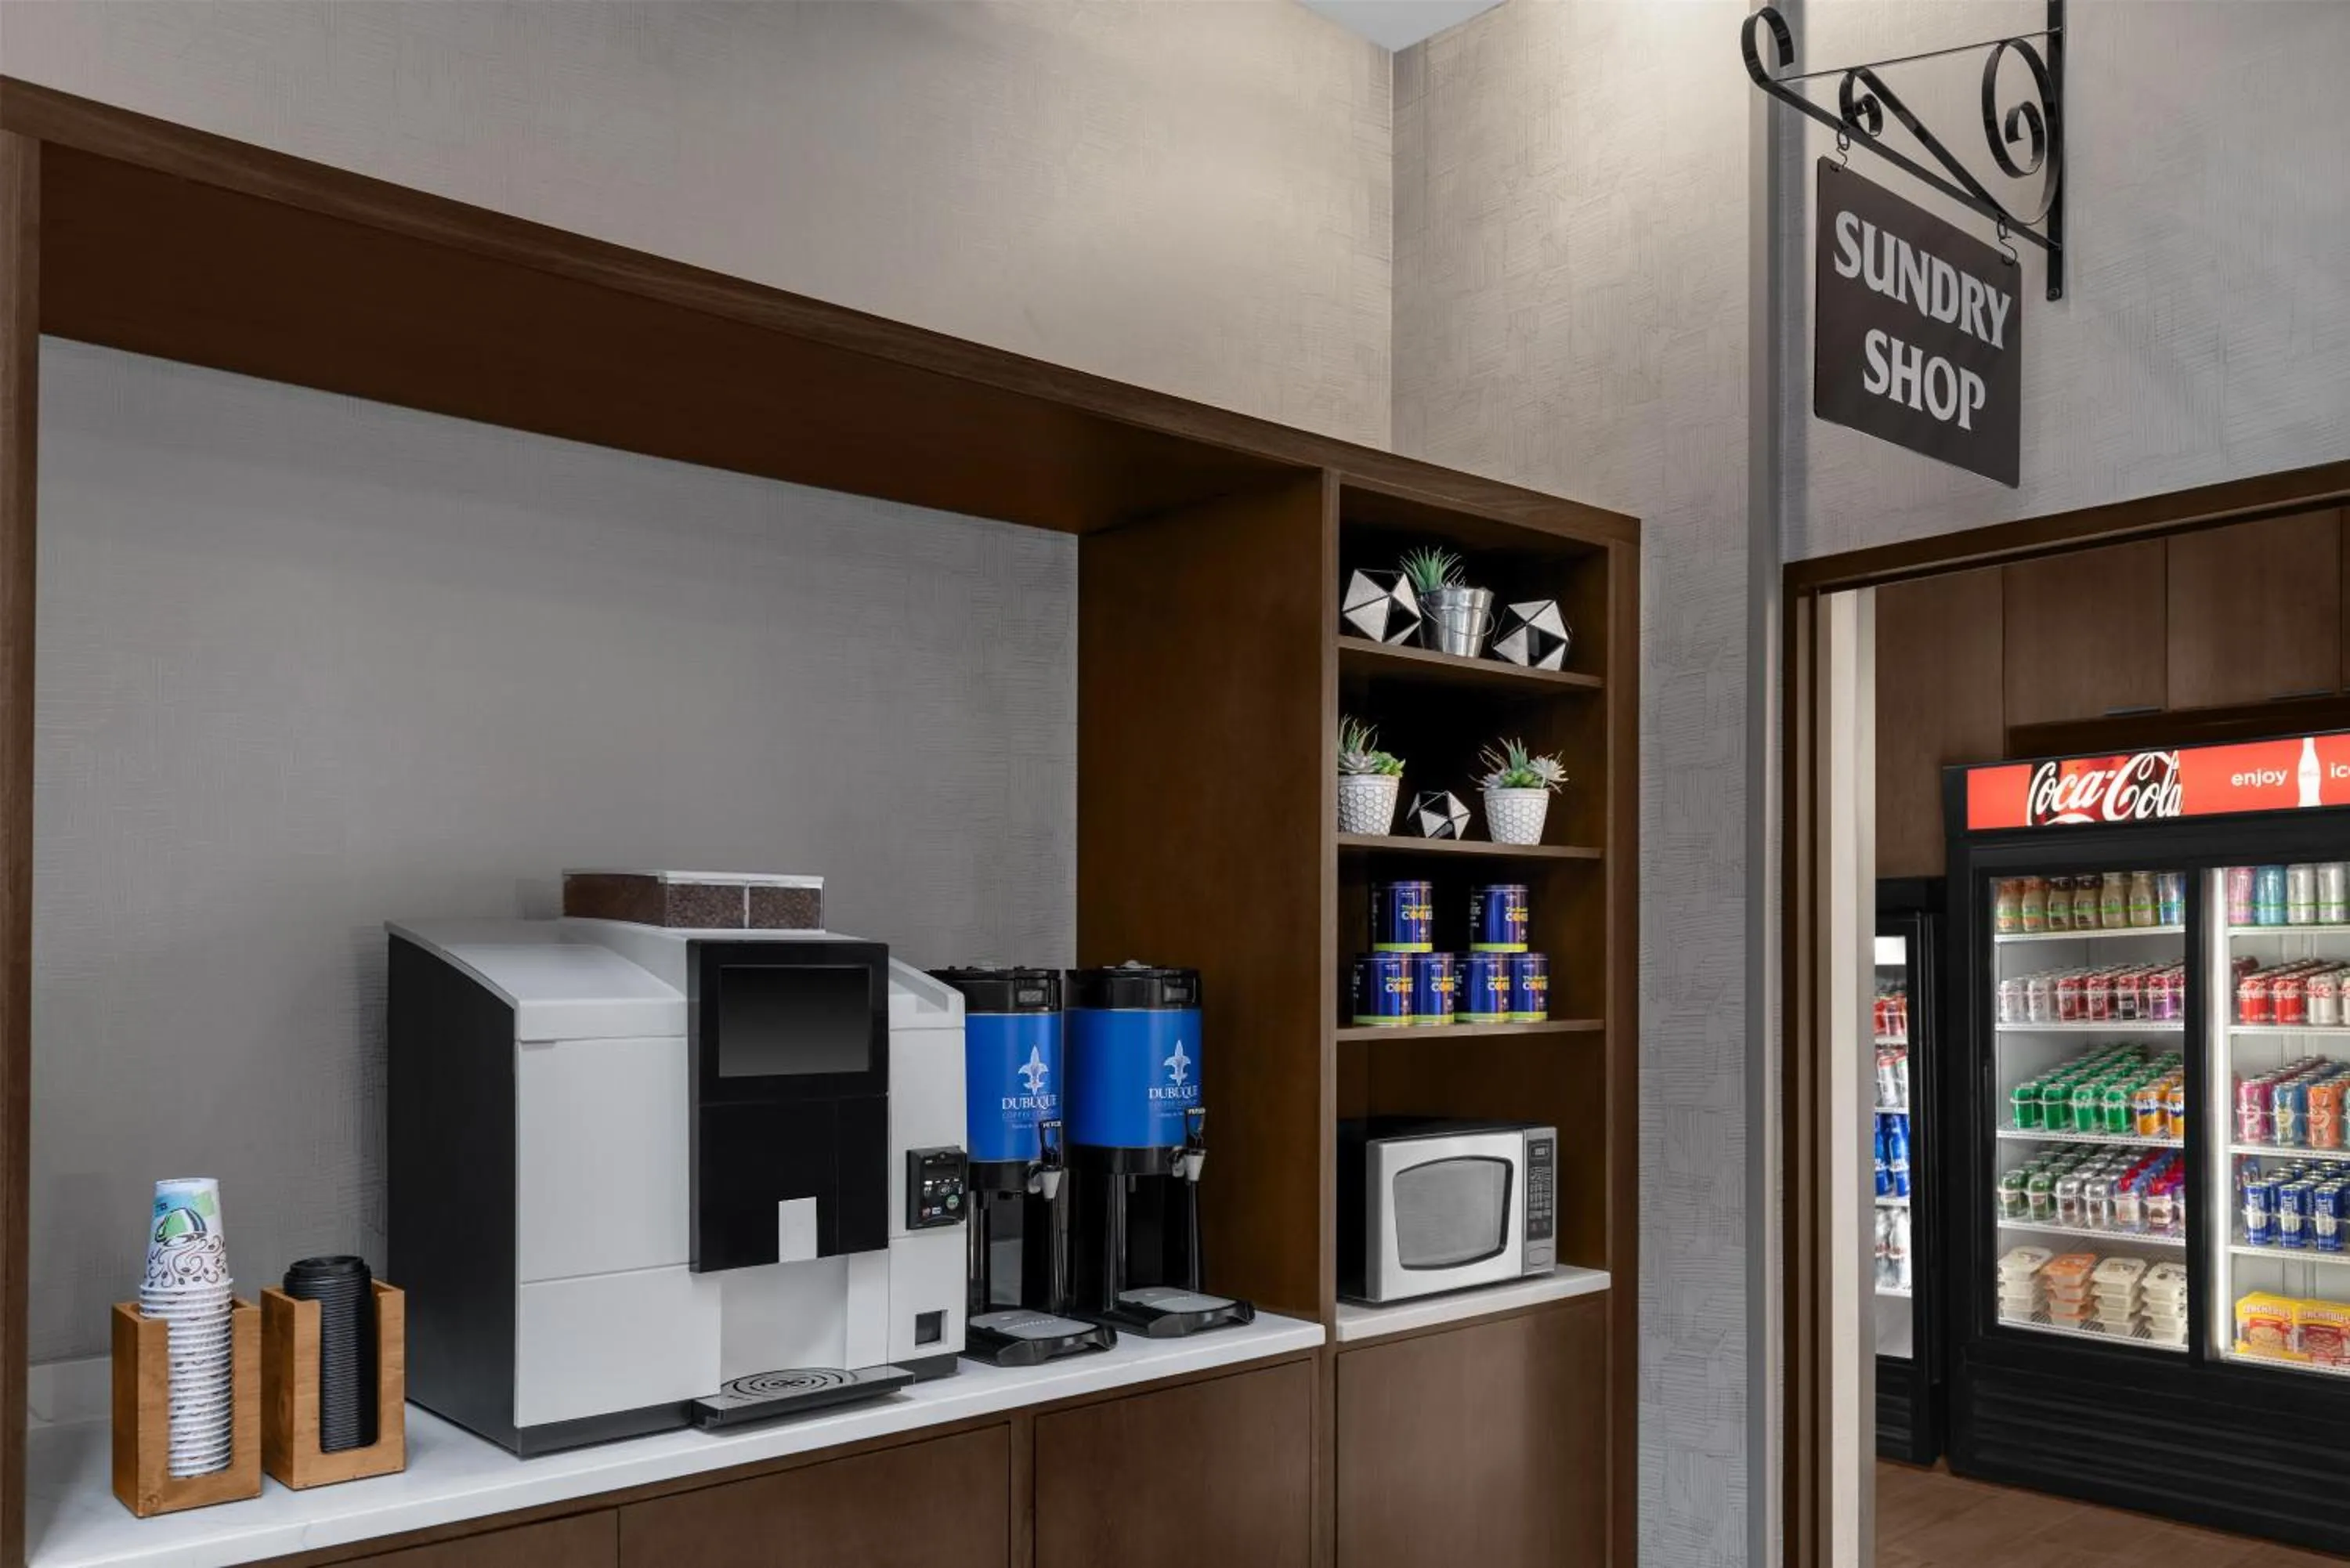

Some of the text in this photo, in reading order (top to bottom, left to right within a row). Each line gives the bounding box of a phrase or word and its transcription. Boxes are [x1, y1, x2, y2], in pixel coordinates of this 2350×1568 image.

[1833, 210, 2012, 350] SUNDRY
[1863, 328, 1986, 431] SHOP
[2026, 750, 2182, 826] Coca-Cola
[2231, 762, 2350, 788] enjoy ic
[1002, 1094, 1059, 1110] DUBUQUE
